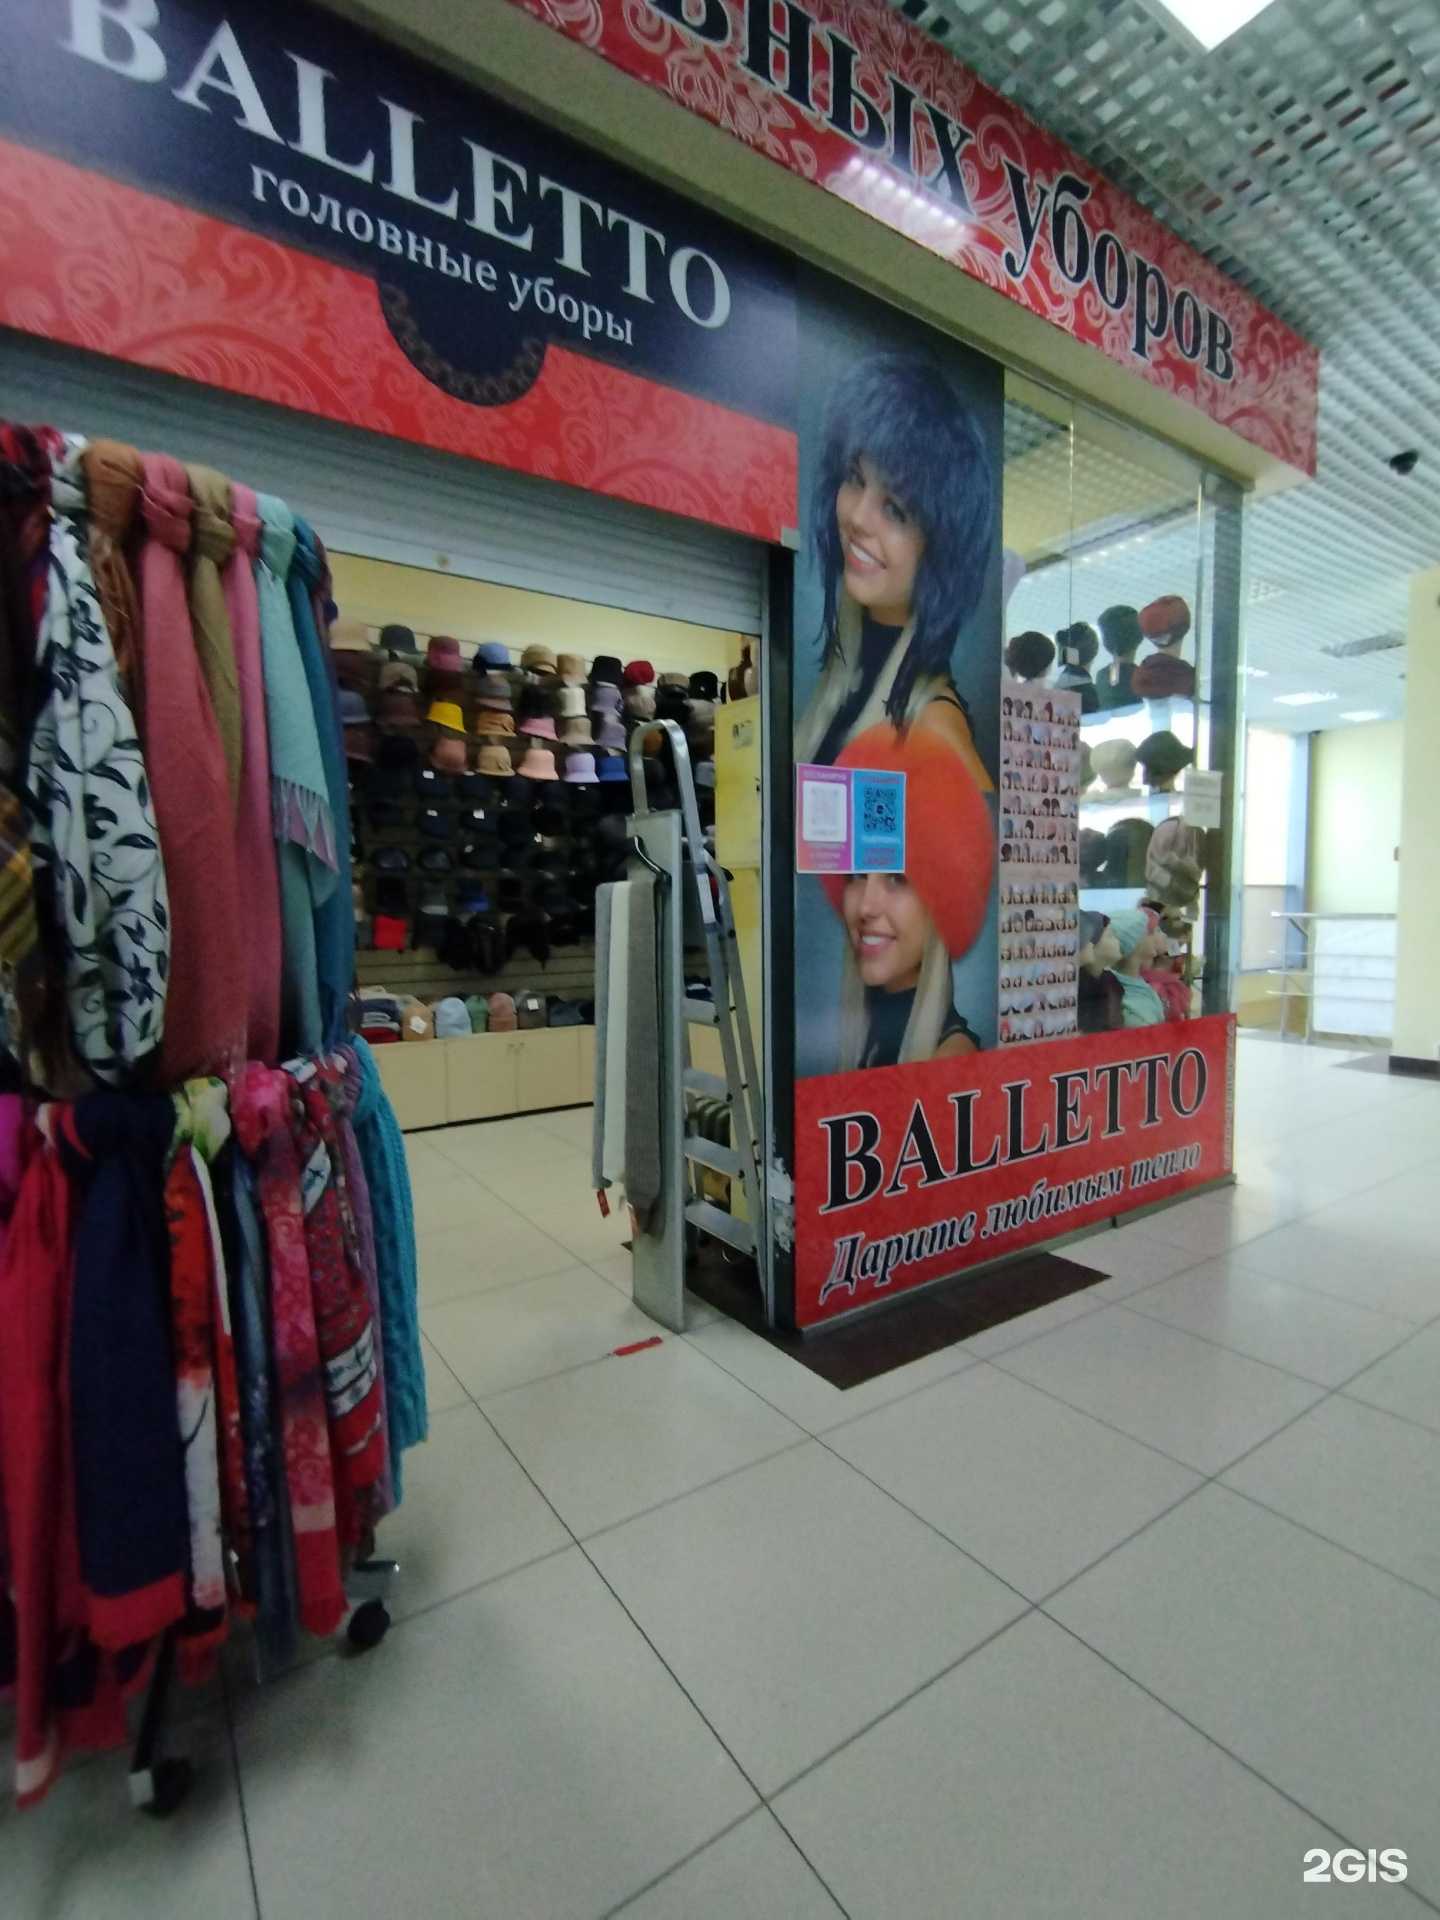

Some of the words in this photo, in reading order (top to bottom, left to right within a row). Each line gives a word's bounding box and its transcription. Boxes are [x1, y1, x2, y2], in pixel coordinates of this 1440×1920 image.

[56, 0, 732, 329] BALLETTO
[250, 164, 498, 292] головные
[507, 272, 635, 347] уборы
[1001, 159, 1235, 382] уборов
[818, 1049, 1208, 1215] BALLETTO
[819, 1211, 976, 1304] Дарите
[981, 1167, 1124, 1239] любимым
[1129, 1142, 1202, 1188] тепло
